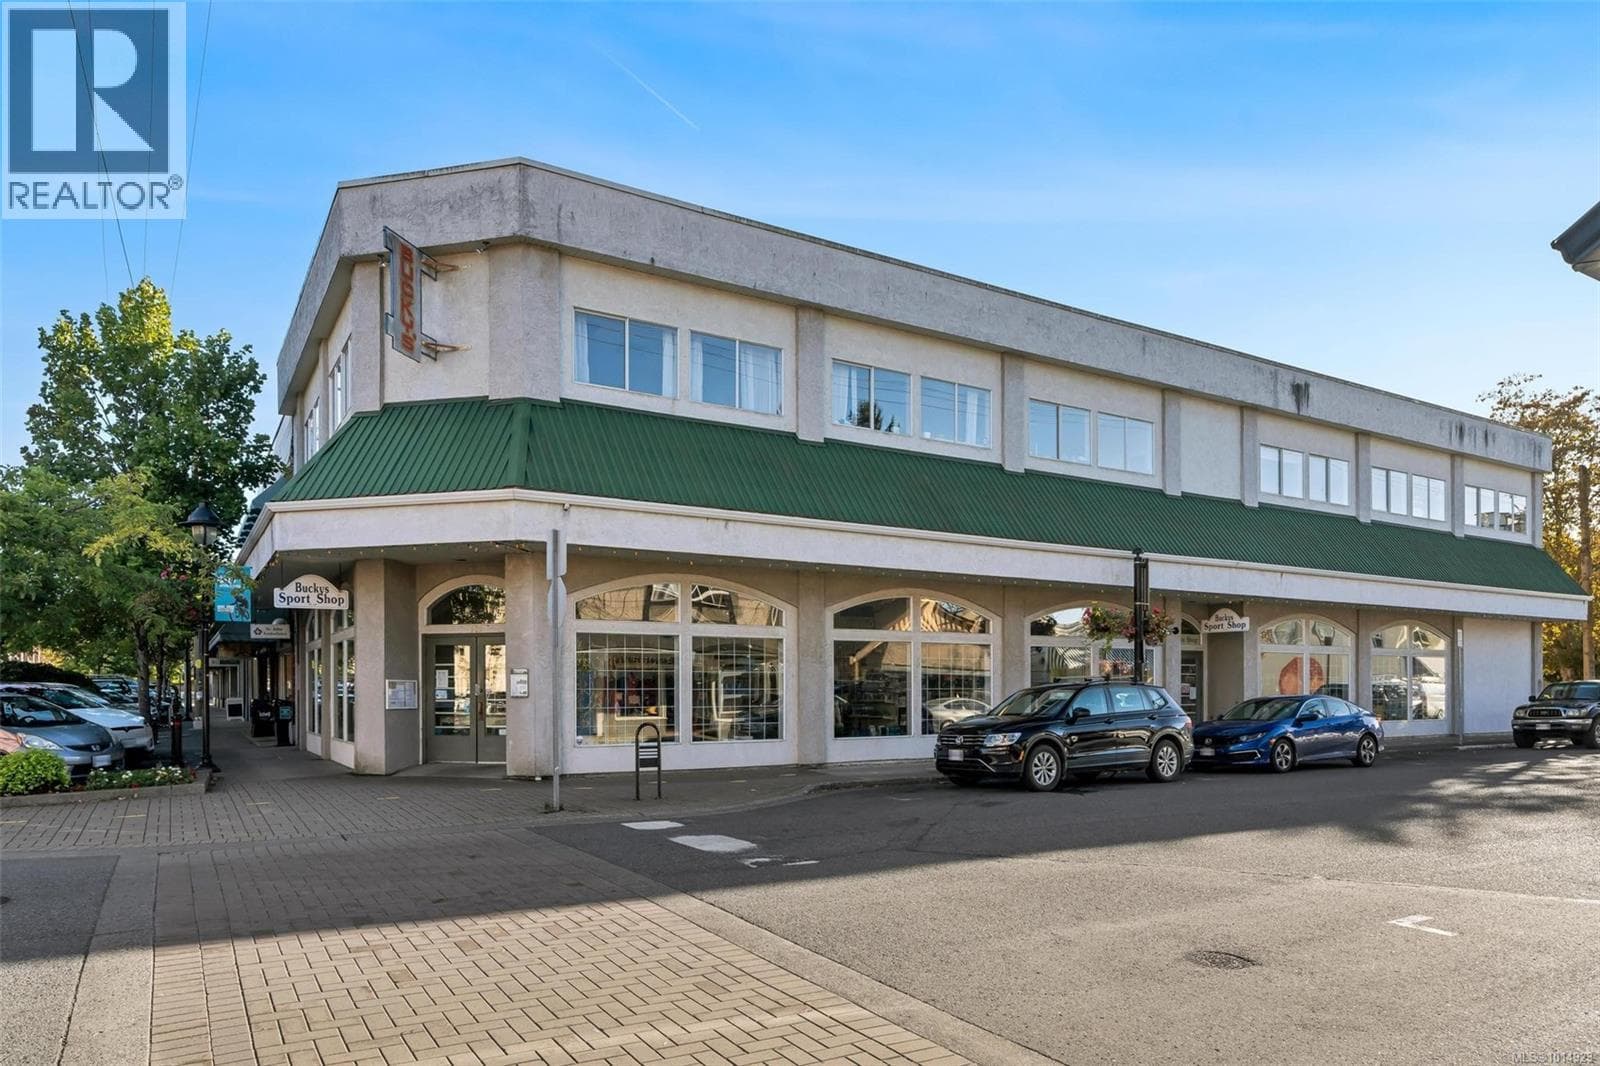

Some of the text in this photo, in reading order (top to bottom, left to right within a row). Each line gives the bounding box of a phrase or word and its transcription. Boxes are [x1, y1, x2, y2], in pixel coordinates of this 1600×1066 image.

[295, 581, 330, 594] Buckys
[278, 592, 345, 607] Sport Shop
[1204, 621, 1247, 631] Sport Shop
